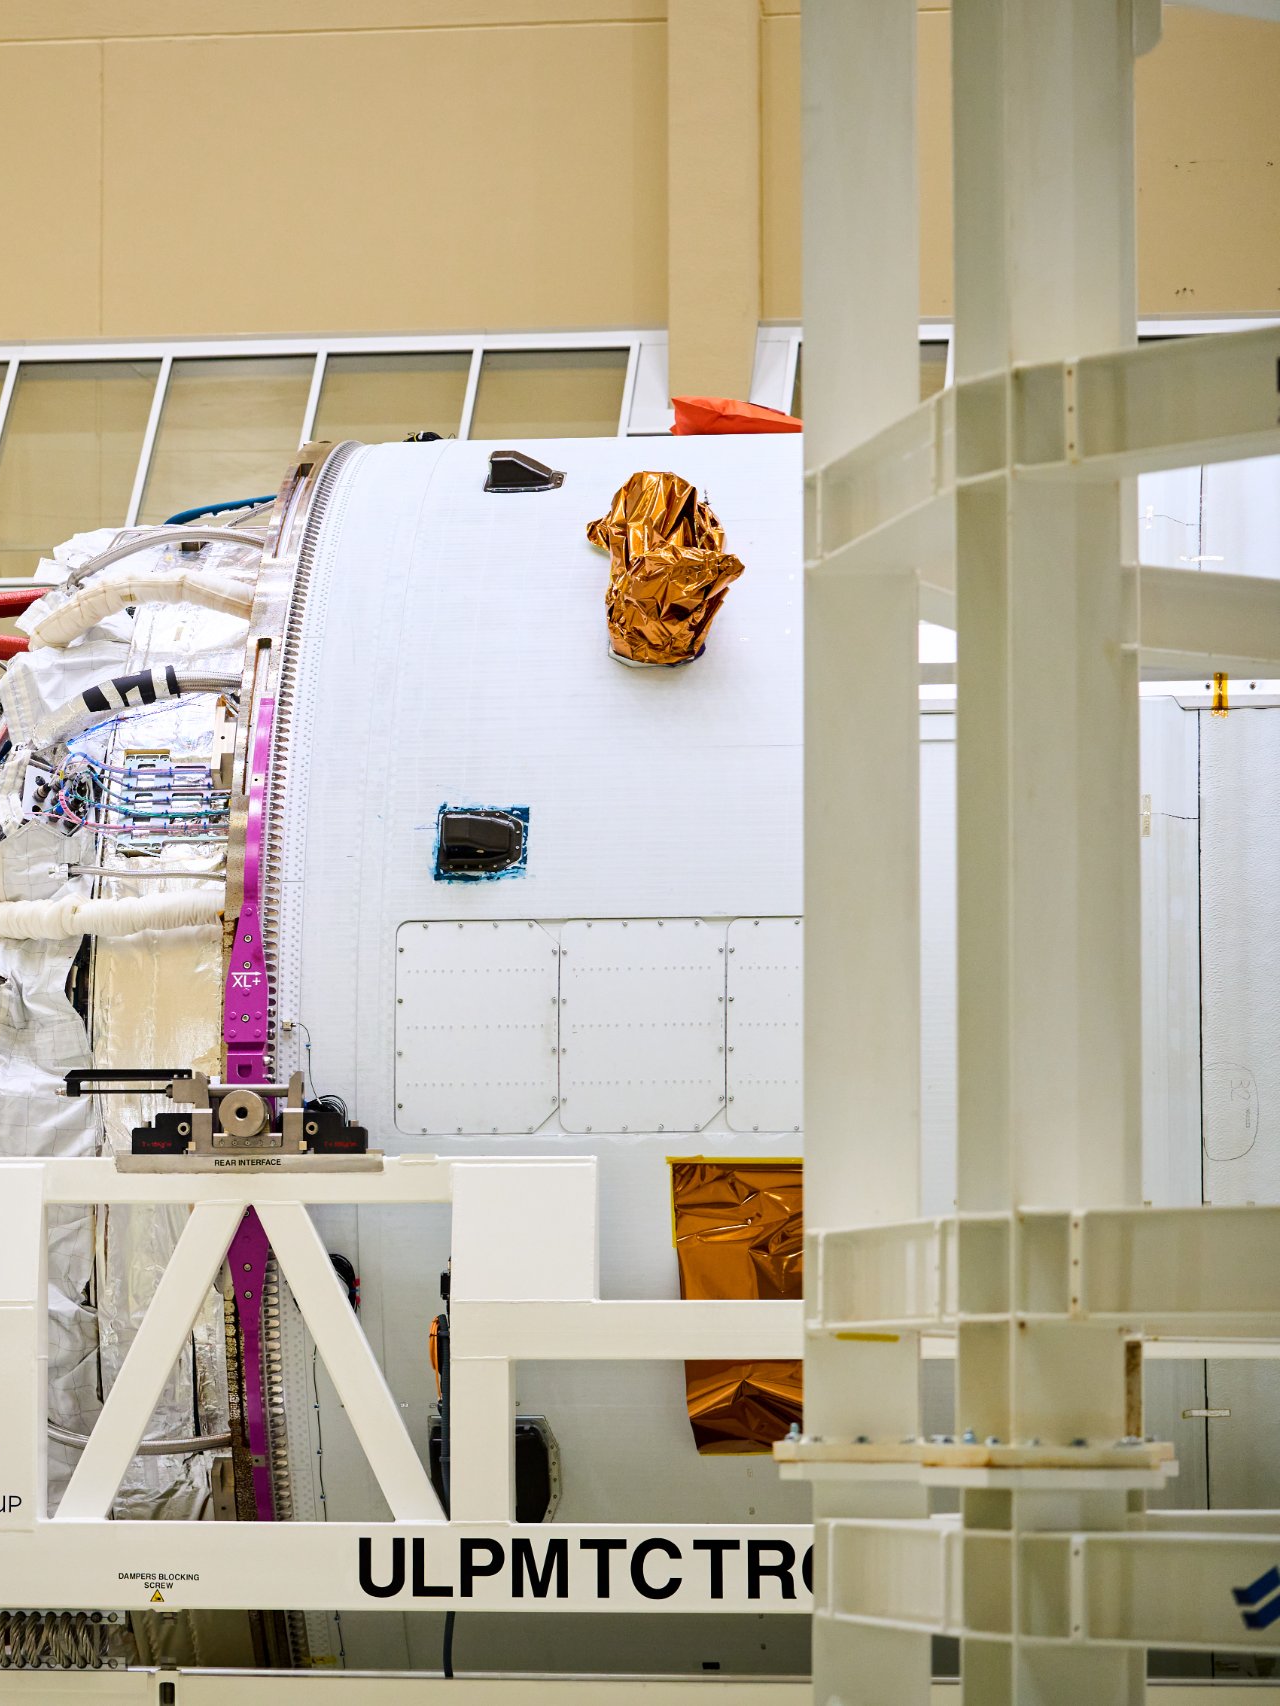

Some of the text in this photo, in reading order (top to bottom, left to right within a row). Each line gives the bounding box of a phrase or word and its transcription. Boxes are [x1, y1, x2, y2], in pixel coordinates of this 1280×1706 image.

[231, 975, 262, 988] XL+
[214, 1158, 282, 1167] REAR INTERFACE
[118, 1572, 200, 1581] DAMPERS BLOCKING
[144, 1581, 174, 1589] SCREW
